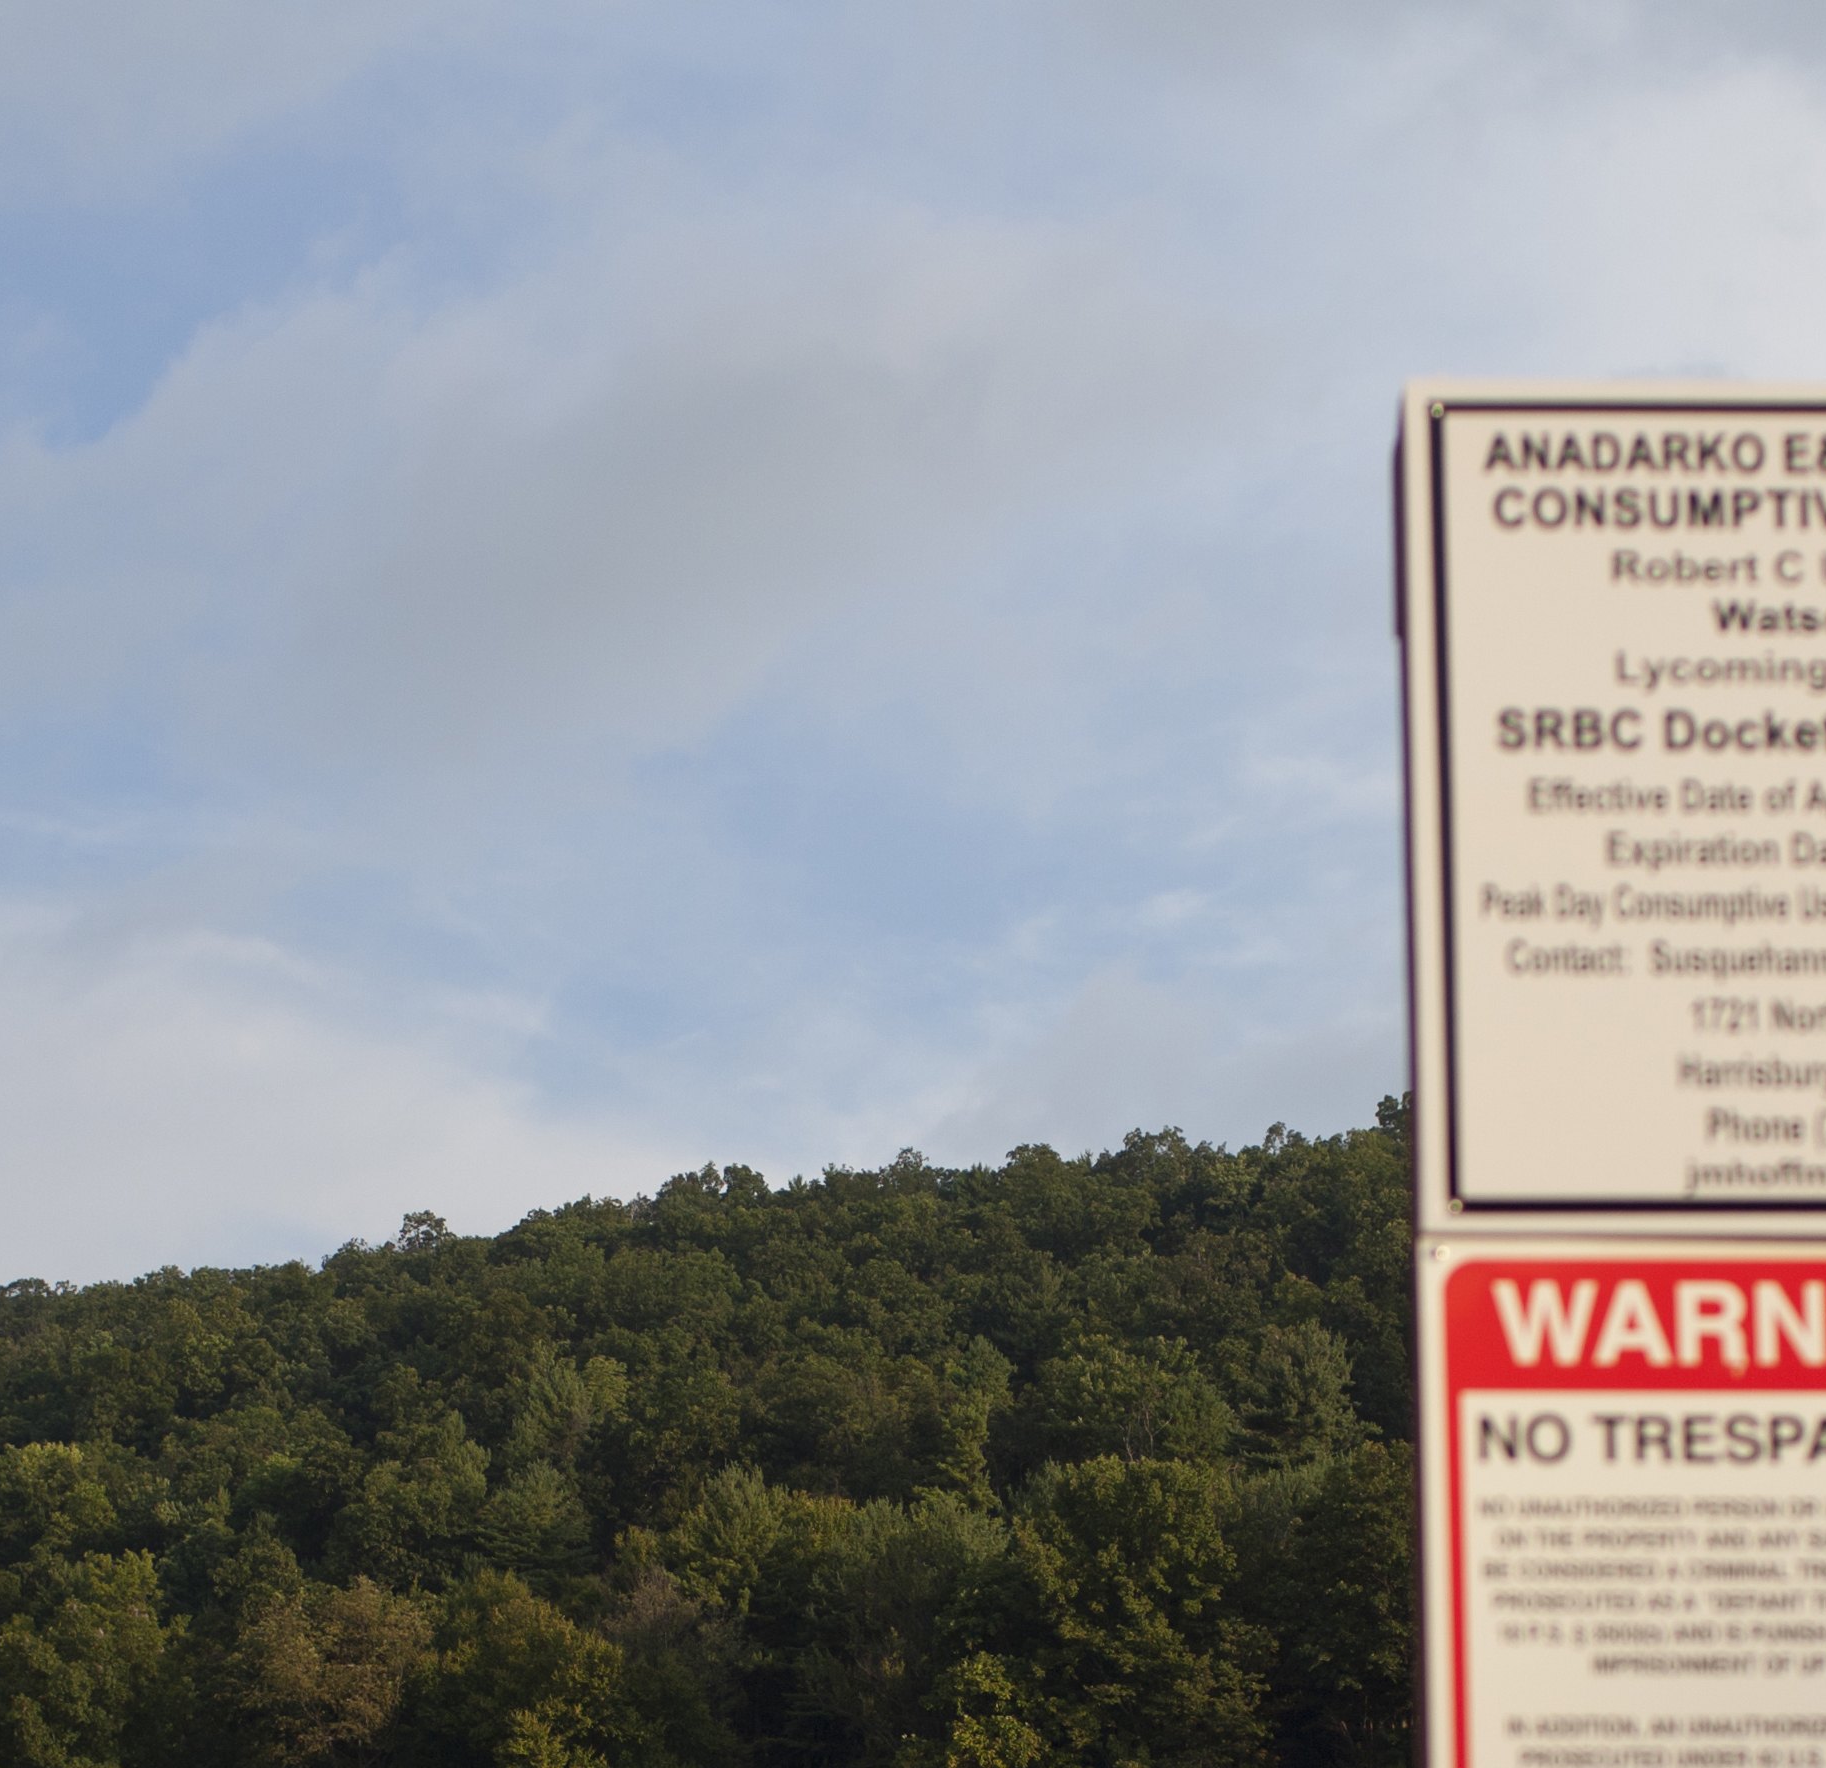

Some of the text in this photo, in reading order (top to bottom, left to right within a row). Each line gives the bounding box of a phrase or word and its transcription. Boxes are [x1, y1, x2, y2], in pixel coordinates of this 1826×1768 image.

[1484, 433, 1765, 476] ANADARKO
[1611, 550, 1758, 585] Robert
[1774, 551, 1802, 586] C
[1498, 708, 1642, 752] SRBC
[1528, 780, 1666, 814] Effective
[1680, 780, 1751, 814] Date
[1764, 781, 1797, 814] of
[1606, 832, 1776, 873] Expiration
[1482, 885, 1544, 920] Peak
[1554, 885, 1604, 929] Day
[1613, 885, 1789, 927] Consumptive
[1692, 998, 1758, 1033] 1721
[1707, 1109, 1803, 1143] Phone
[1478, 1414, 1571, 1464] NO
